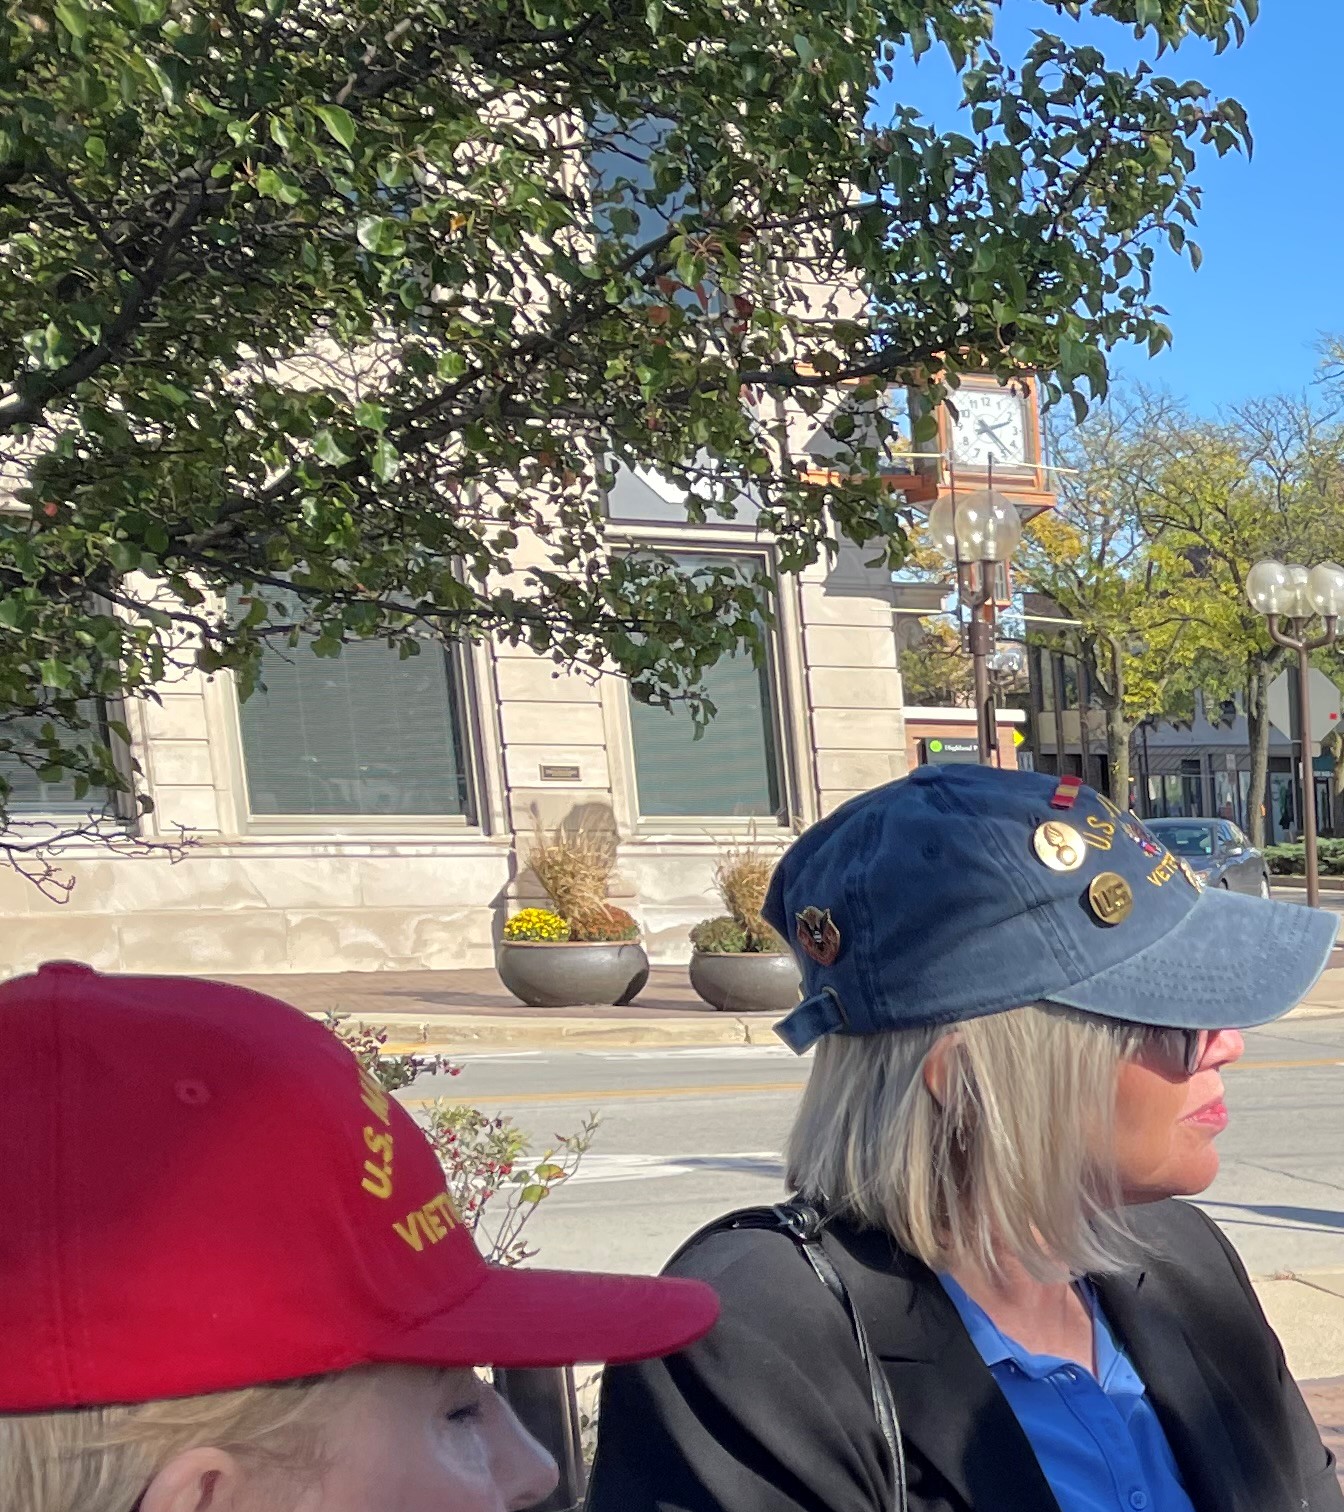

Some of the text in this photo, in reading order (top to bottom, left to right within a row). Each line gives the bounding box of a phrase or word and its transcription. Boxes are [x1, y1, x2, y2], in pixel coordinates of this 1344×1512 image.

[970, 399, 978, 409] 11
[981, 397, 991, 407] 12
[960, 408, 970, 418] 10
[1007, 411, 1013, 421] 2
[1013, 425, 1018, 436] 3
[963, 436, 969, 446] 8
[1010, 440, 1018, 449] 4
[973, 447, 980, 458] 7
